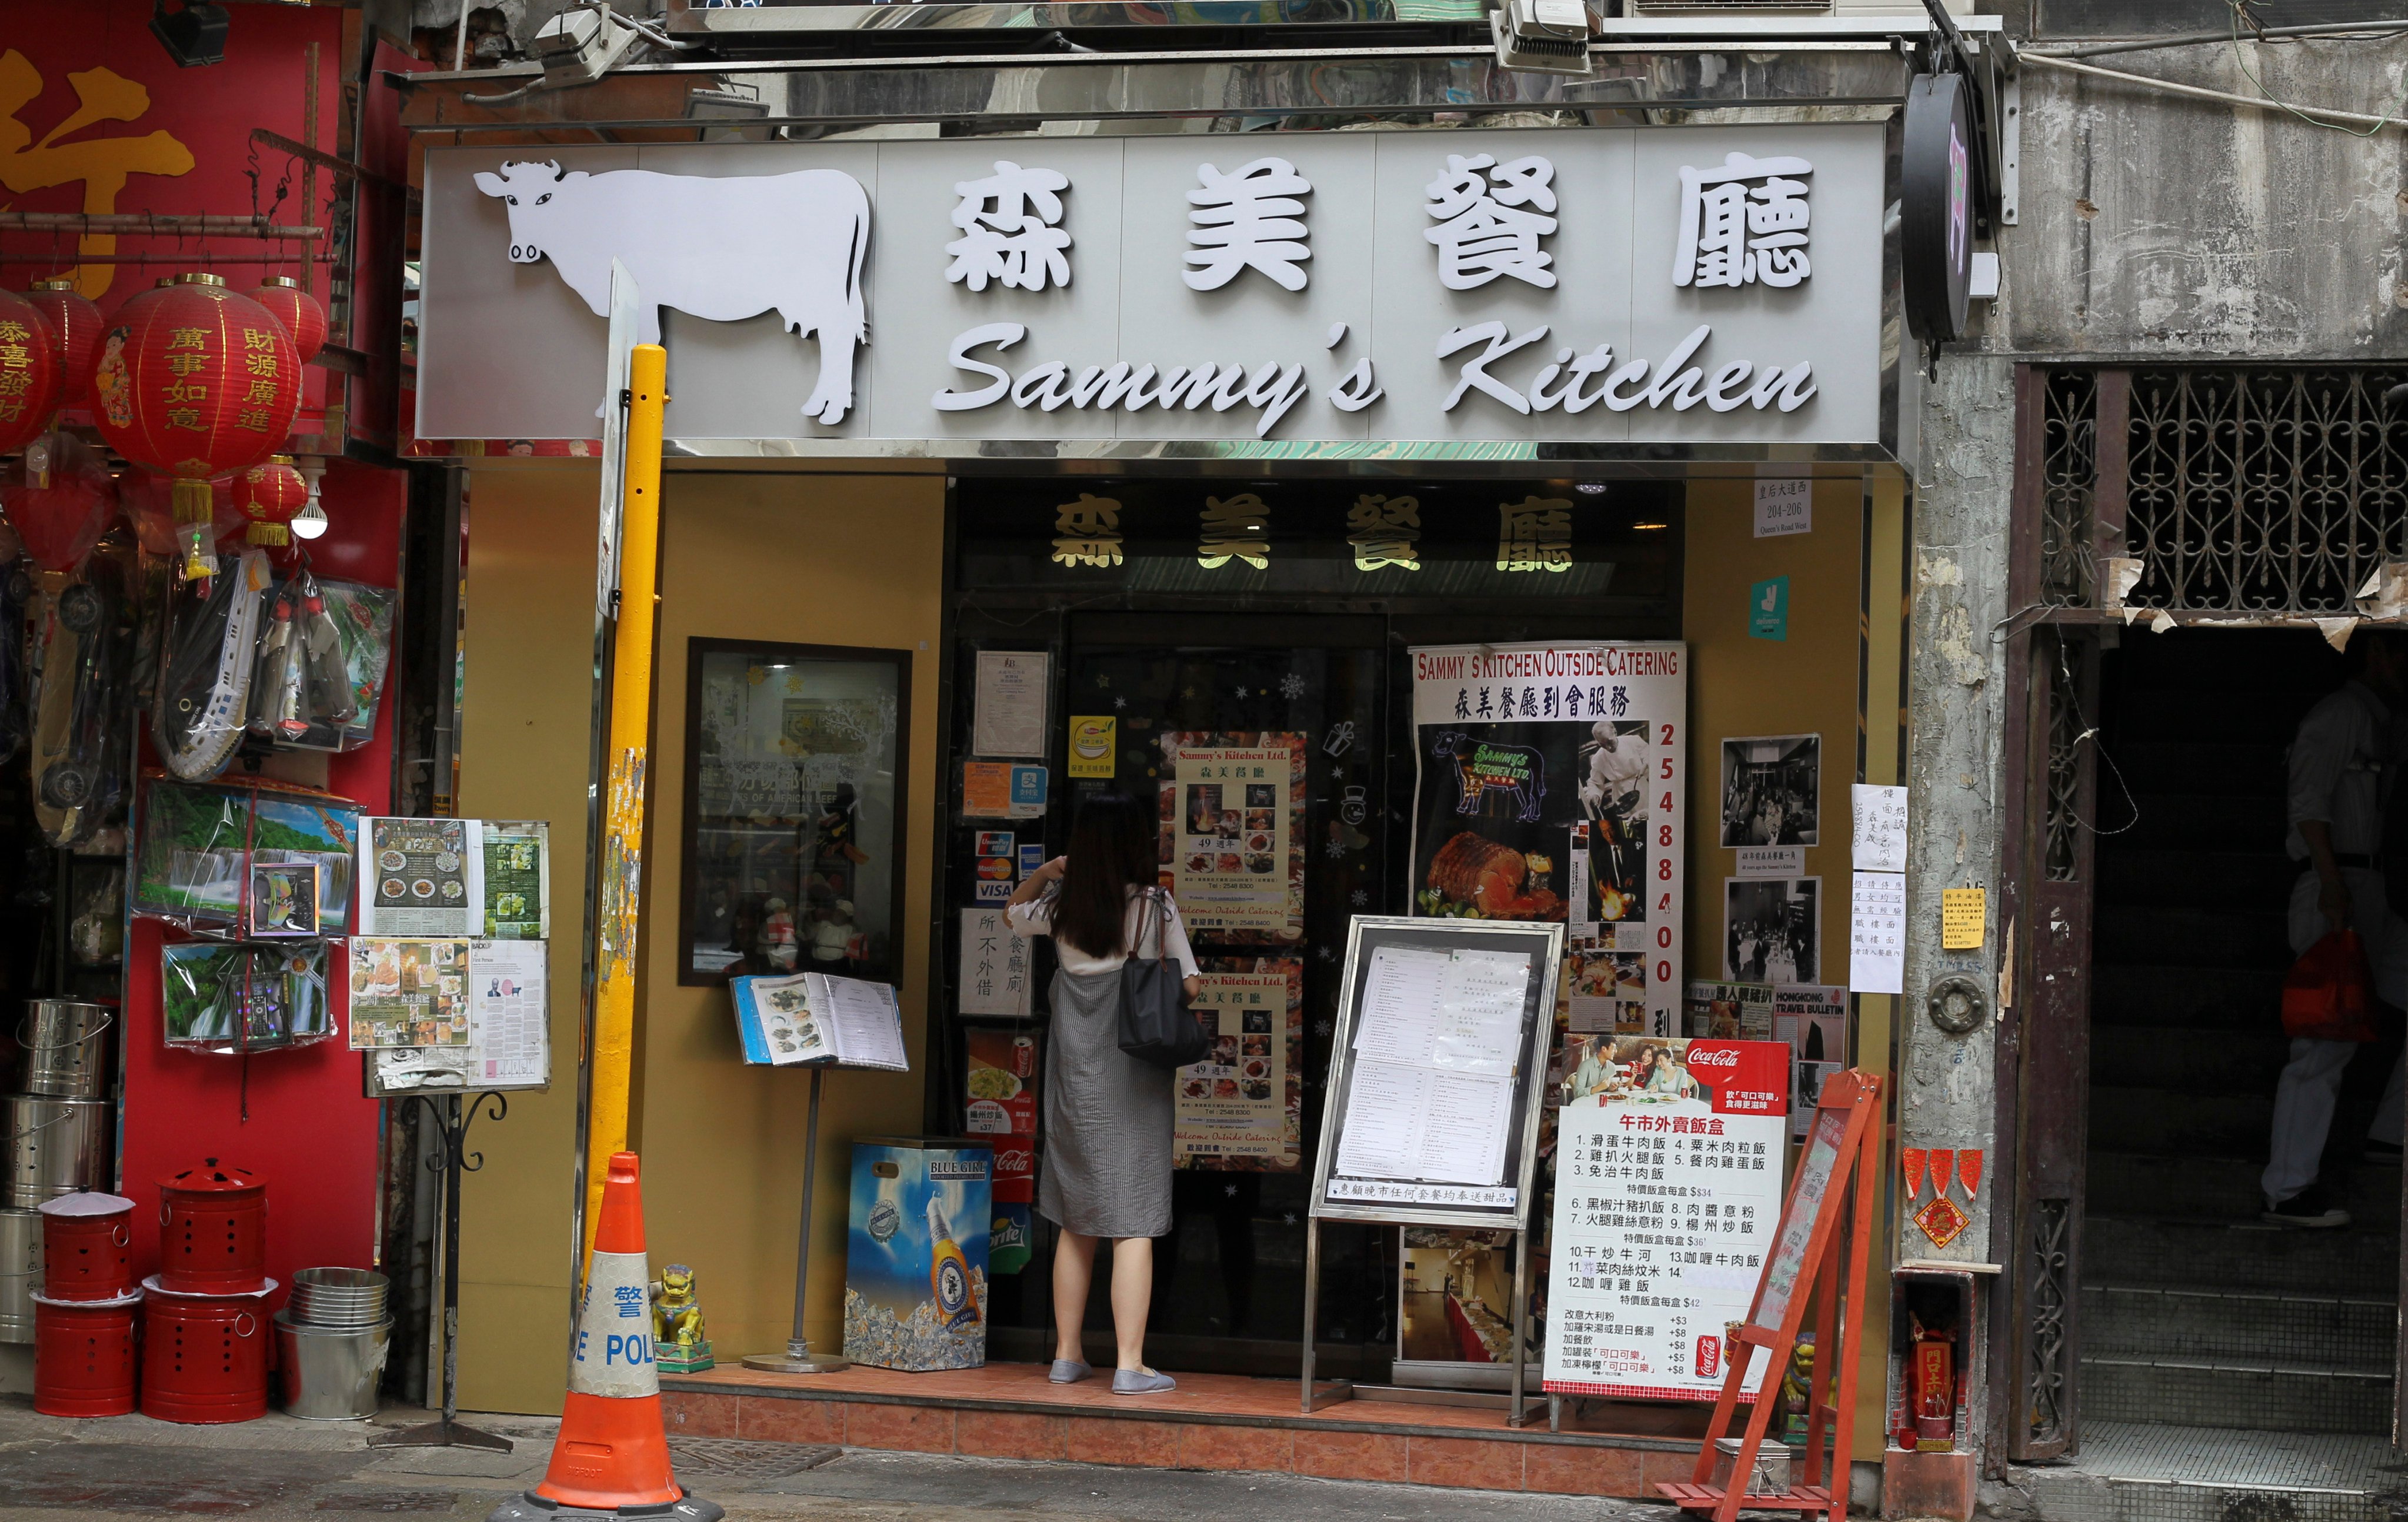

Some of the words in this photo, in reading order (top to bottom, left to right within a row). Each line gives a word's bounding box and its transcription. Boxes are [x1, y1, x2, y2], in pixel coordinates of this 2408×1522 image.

[944, 151, 1813, 292] 森美餐廳
[162, 326, 212, 432] 萬事如意
[235, 327, 281, 433] 財源廣進
[931, 321, 1385, 439] Sammy's
[1436, 320, 1819, 415] Kitchen
[1759, 480, 1806, 501] 皇后大道西
[1767, 502, 1802, 519] 204-206
[1050, 493, 1573, 572] 森美餐廳
[1760, 523, 1779, 535] Queen's
[1781, 522, 1794, 532] Road
[1795, 521, 1807, 530] West
[1455, 684, 1630, 720] 森美餐廳到會服務
[1179, 750, 1222, 762] Sammy's
[1225, 751, 1264, 760] Kitchen
[1266, 751, 1286, 760] Ltd.
[1200, 766, 1264, 777] 森美餐廳
[1198, 838, 1210, 847] 49
[1216, 839, 1235, 849] 週年
[979, 885, 1011, 897] VISA
[1178, 906, 1212, 914] Welcome
[976, 915, 999, 997] 所不外借
[1220, 976, 1261, 986] Kitchen
[1263, 977, 1283, 986] Ltd.
[1776, 1003, 1805, 1014] TRAVEL
[1807, 1004, 1844, 1015] BULLETIN
[1194, 1065, 1206, 1074] 49
[1726, 1089, 1779, 1102] 飲「可口可樂」
[1725, 1099, 1768, 1110] 食得更滋味
[1619, 1113, 1725, 1136] 午市外賣飯盒
[1590, 1133, 1666, 1151] 滑蛋牛肉飯
[1690, 1139, 1766, 1156] 粟米肉粒飯
[931, 1162, 958, 1173] BLUE
[960, 1162, 985, 1173] GIRL
[1589, 1149, 1665, 1166] 雞扒火腿飯
[1689, 1154, 1765, 1171] 餐肉雞蛋飯
[1588, 1164, 1664, 1181] 免治牛肉飯
[1338, 1183, 1507, 1204] 惠顧晚市任何套餐均奉送甜品
[1627, 1184, 1687, 1197] 特價飯盒每盒
[1586, 1198, 1665, 1215] 黑椒汁豬扒飯
[1686, 1203, 1755, 1219] 肉醬意粉
[1586, 1213, 1663, 1230] 火腿雞絲意粉
[1624, 1233, 1685, 1247] 特價飯盒每盒
[1583, 1246, 1652, 1262] 干炒牛河
[613, 1286, 643, 1317] 警
[1620, 1294, 1680, 1309] 特價飯盒每盒
[1683, 1297, 1700, 1309] $42
[1564, 1310, 1615, 1321] 改意大利粉
[1670, 1316, 1687, 1326] +$3
[1563, 1321, 1655, 1337] 加羅宋湯或是日餐湯
[1669, 1329, 1686, 1338] +$8
[1562, 1334, 1593, 1346] 加餐飲
[1668, 1341, 1686, 1350] +$8
[1667, 1353, 1685, 1363] +$5
[1667, 1366, 1685, 1375] +$8
